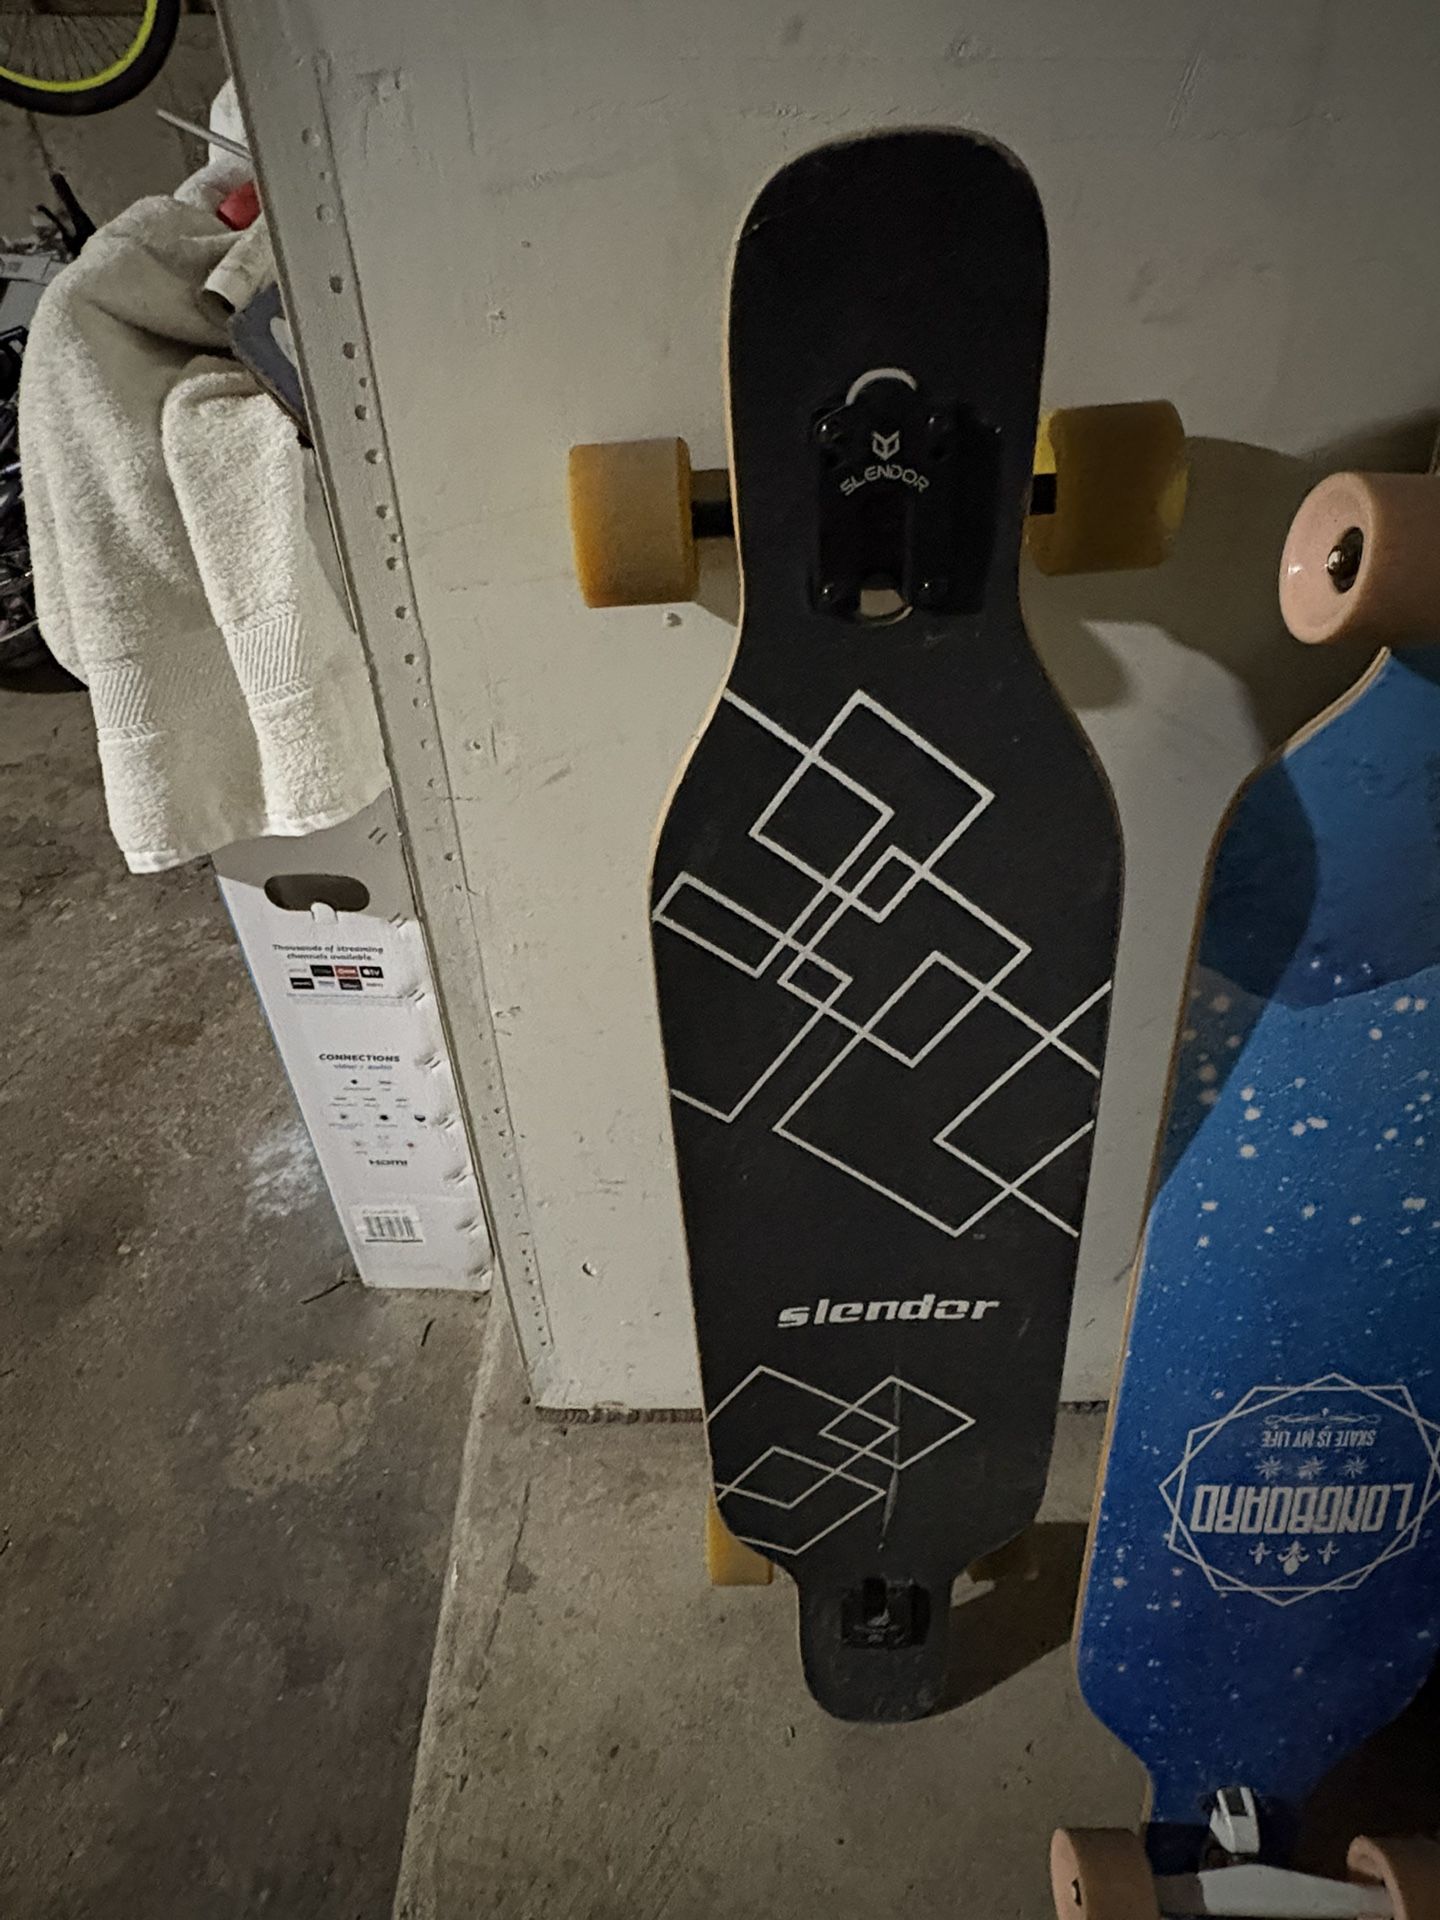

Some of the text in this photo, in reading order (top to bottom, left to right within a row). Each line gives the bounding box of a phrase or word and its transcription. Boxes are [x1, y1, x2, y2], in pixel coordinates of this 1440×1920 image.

[840, 464, 930, 496] SLENDOR
[272, 944, 322, 952] Thousands
[336, 946, 384, 954] streaming
[319, 1053, 400, 1062] CONNECTIONS
[777, 1294, 1000, 1328] slendor
[1262, 1428, 1377, 1448] SKATE IS MY LIFE
[1190, 1483, 1415, 1534] LONGBOARD
